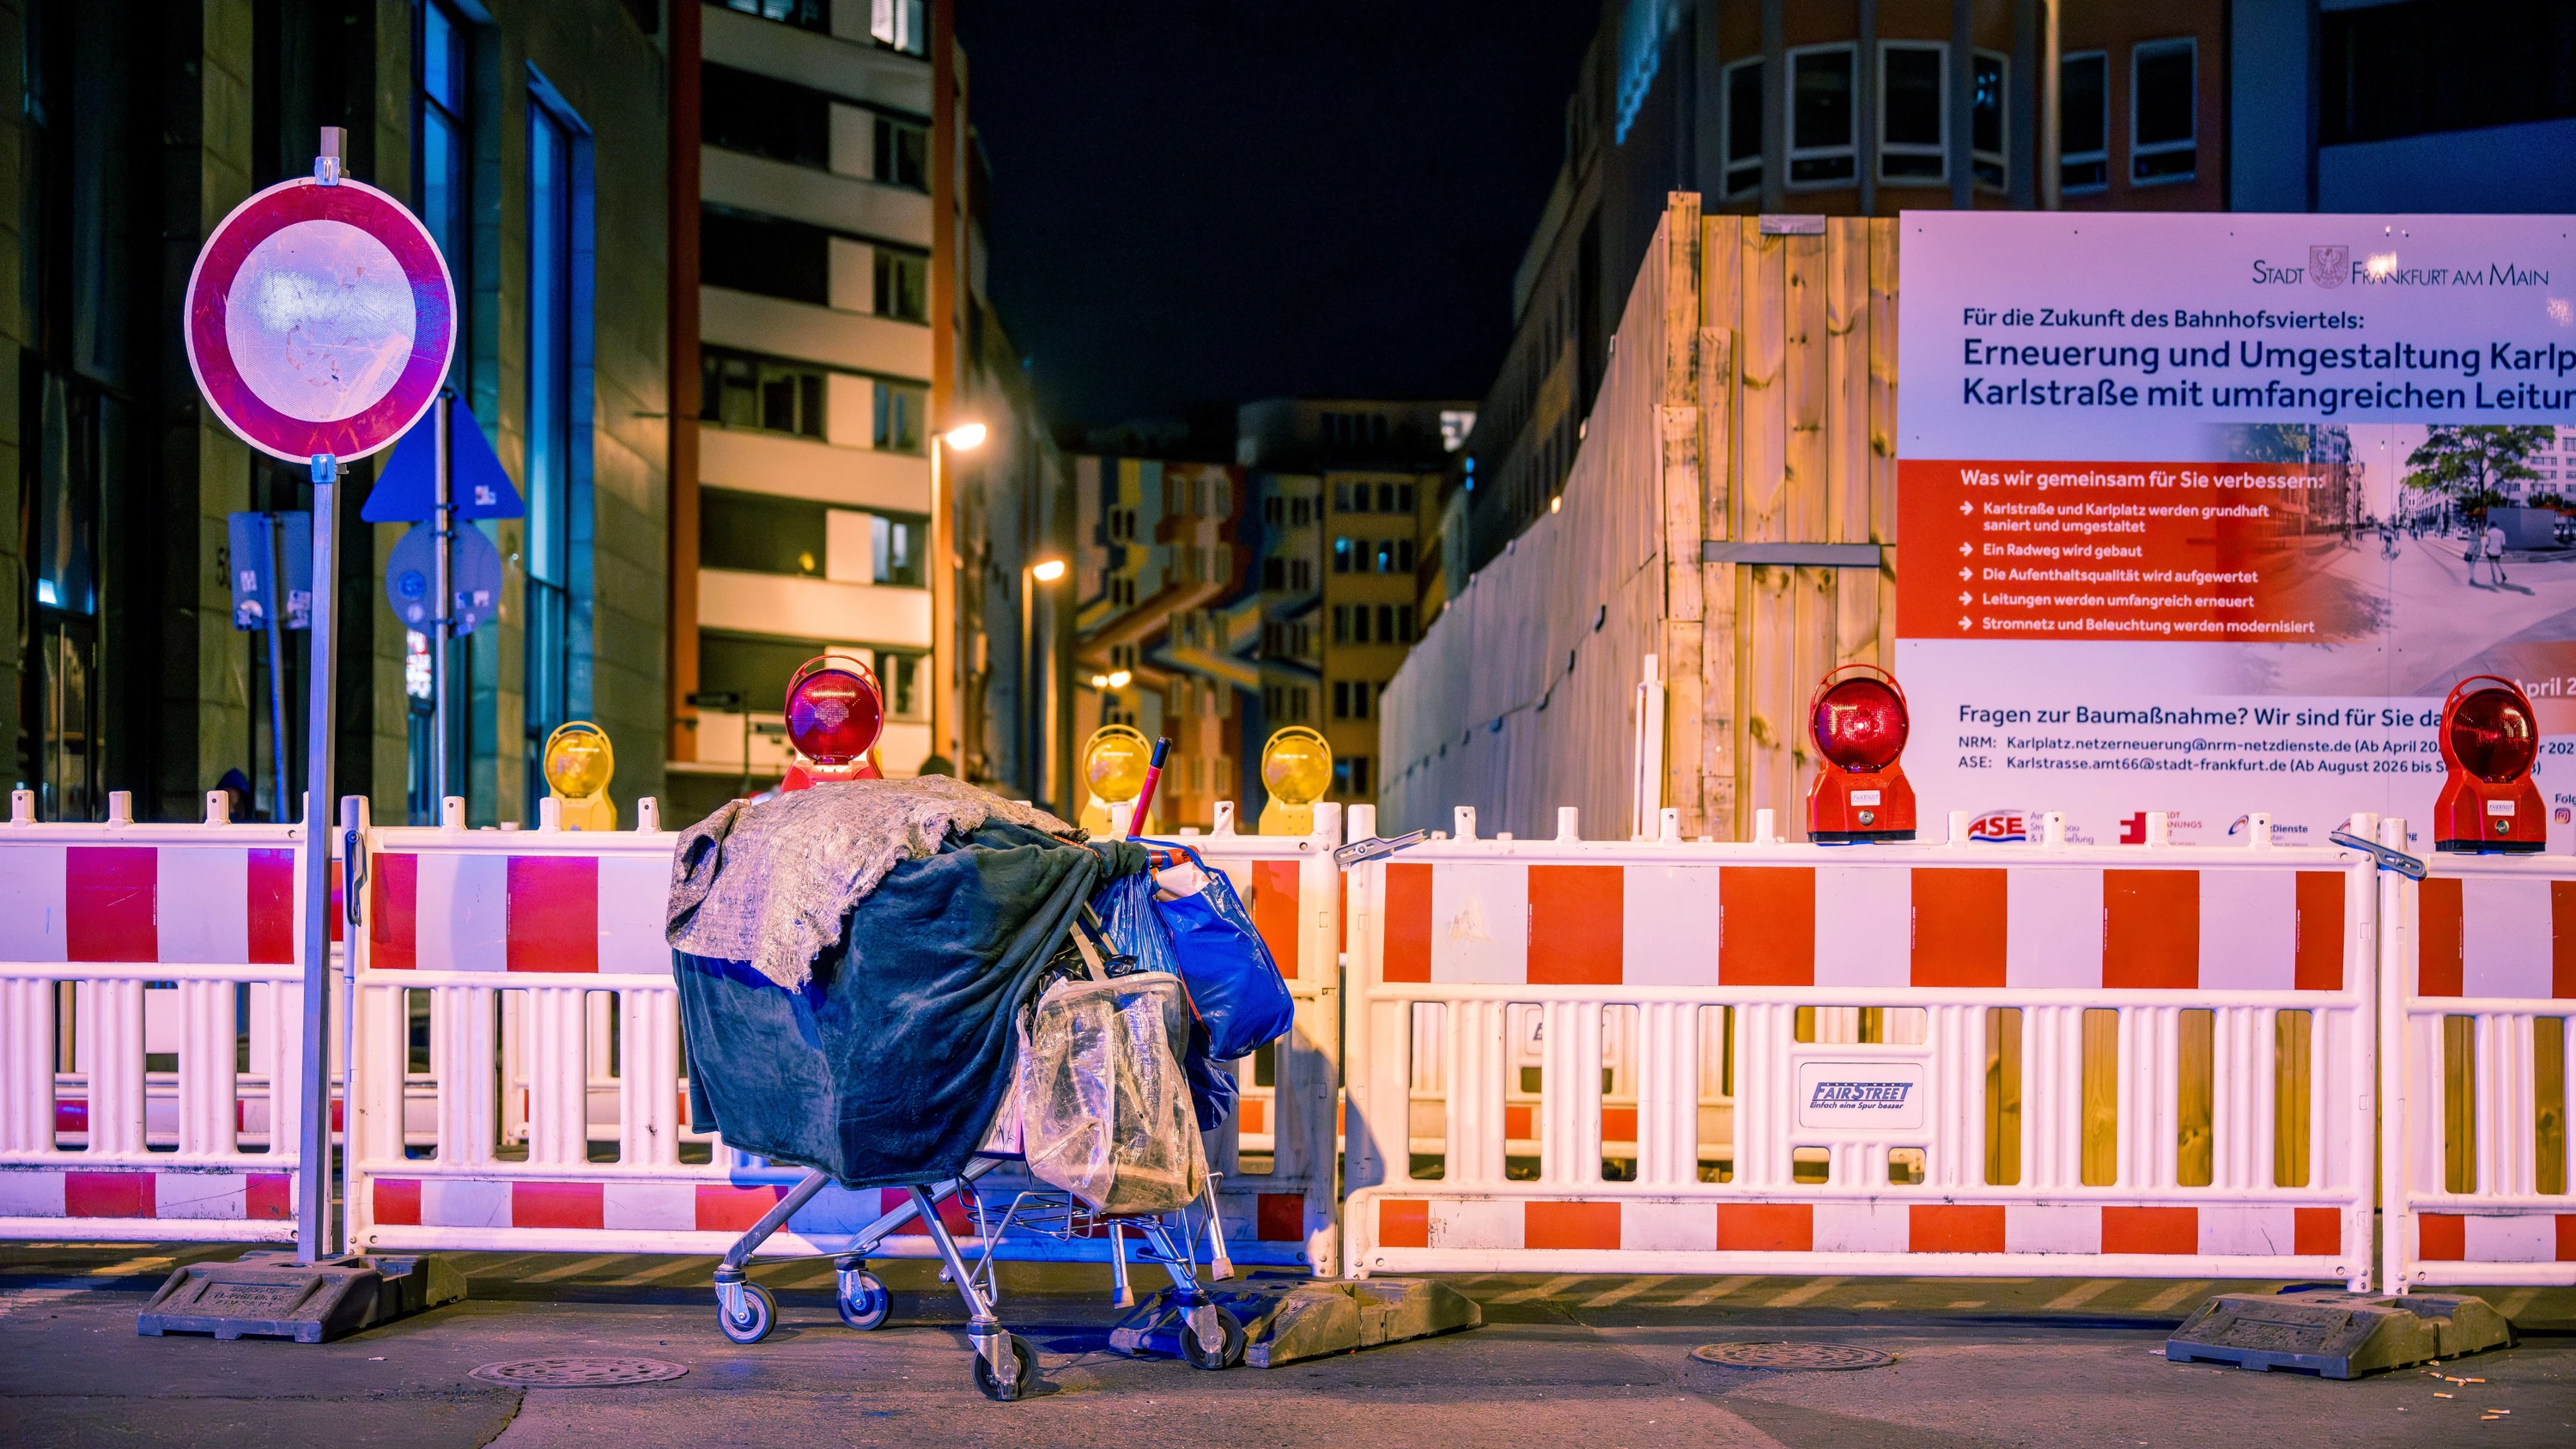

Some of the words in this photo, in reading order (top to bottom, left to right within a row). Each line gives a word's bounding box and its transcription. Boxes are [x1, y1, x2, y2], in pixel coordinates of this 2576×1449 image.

[1964, 307, 1996, 326] Für
[2002, 307, 2034, 326] die
[2040, 308, 2125, 327] Zukunft
[2131, 309, 2168, 328] des
[2175, 309, 2365, 329] Bahnhofsviertels:
[1964, 338, 2160, 374] Erneuerung
[2170, 340, 2230, 368] und
[2240, 341, 2481, 377] Umgestaltung
[1964, 378, 2138, 406] Karlstraße
[2148, 380, 2204, 407] mit
[2213, 381, 2465, 415] umfangreichen
[1960, 469, 2001, 486] Was
[2004, 469, 2033, 486] wir
[2037, 470, 2145, 490] gemeinsam
[2149, 471, 2177, 488] für
[2180, 471, 2209, 489] Sie
[2213, 472, 2324, 490] verbessern:
[1984, 502, 2055, 515] Karlstraße
[2057, 502, 2083, 516] und
[2086, 503, 2146, 519] Karlplatz
[2148, 504, 2199, 517] werden
[2202, 504, 2270, 521] grundhaft
[1984, 519, 2031, 532] saniert
[2034, 520, 2060, 532] und
[2063, 520, 2146, 535] umgestaltet
[1984, 543, 2005, 556] Ein
[2008, 544, 2060, 559] Radweg
[2063, 544, 2093, 557] wird
[2095, 545, 2143, 560] gebaut
[1983, 568, 2007, 581] Die
[2008, 568, 2140, 585] Aufenthaltsqualität
[2142, 569, 2172, 582] wird
[2175, 569, 2259, 586] aufgewertet
[1983, 593, 2051, 608] Leitungen
[2054, 594, 2105, 606] werden
[2107, 594, 2192, 610] umfangreich
[2195, 595, 2255, 608] erneuert
[1983, 617, 2055, 630] Stromnetz
[2058, 618, 2083, 630] und
[2087, 618, 2171, 635] Beleuchtung
[2173, 619, 2225, 632] werden
[2227, 620, 2316, 634] modernisiert
[1960, 705, 2032, 728] Fragen
[2038, 709, 2071, 723] zur
[2077, 706, 2248, 726] Baumaßnahme?
[2254, 708, 2290, 726] Wir
[2297, 708, 2339, 727] sind
[2345, 709, 2376, 727] für
[2382, 709, 2414, 727] Sie
[1959, 736, 1996, 749] NRM:
[2008, 737, 2351, 754] Karlplatz.netzerneuerung@nrm-netzdienste.de
[2355, 740, 2379, 754] (Ab
[2383, 740, 2416, 756] April
[2421, 741, 2440, 753] 20
[1959, 756, 1992, 769] ASE:
[2008, 757, 2286, 772] Karlstrasse.amt66@stadt-frankfurt.de
[2291, 758, 2315, 773] (Ab
[2318, 760, 2369, 775] August
[2373, 760, 2408, 773] 2026
[2412, 761, 2432, 773] bis
[1968, 817, 2026, 836] ASE
